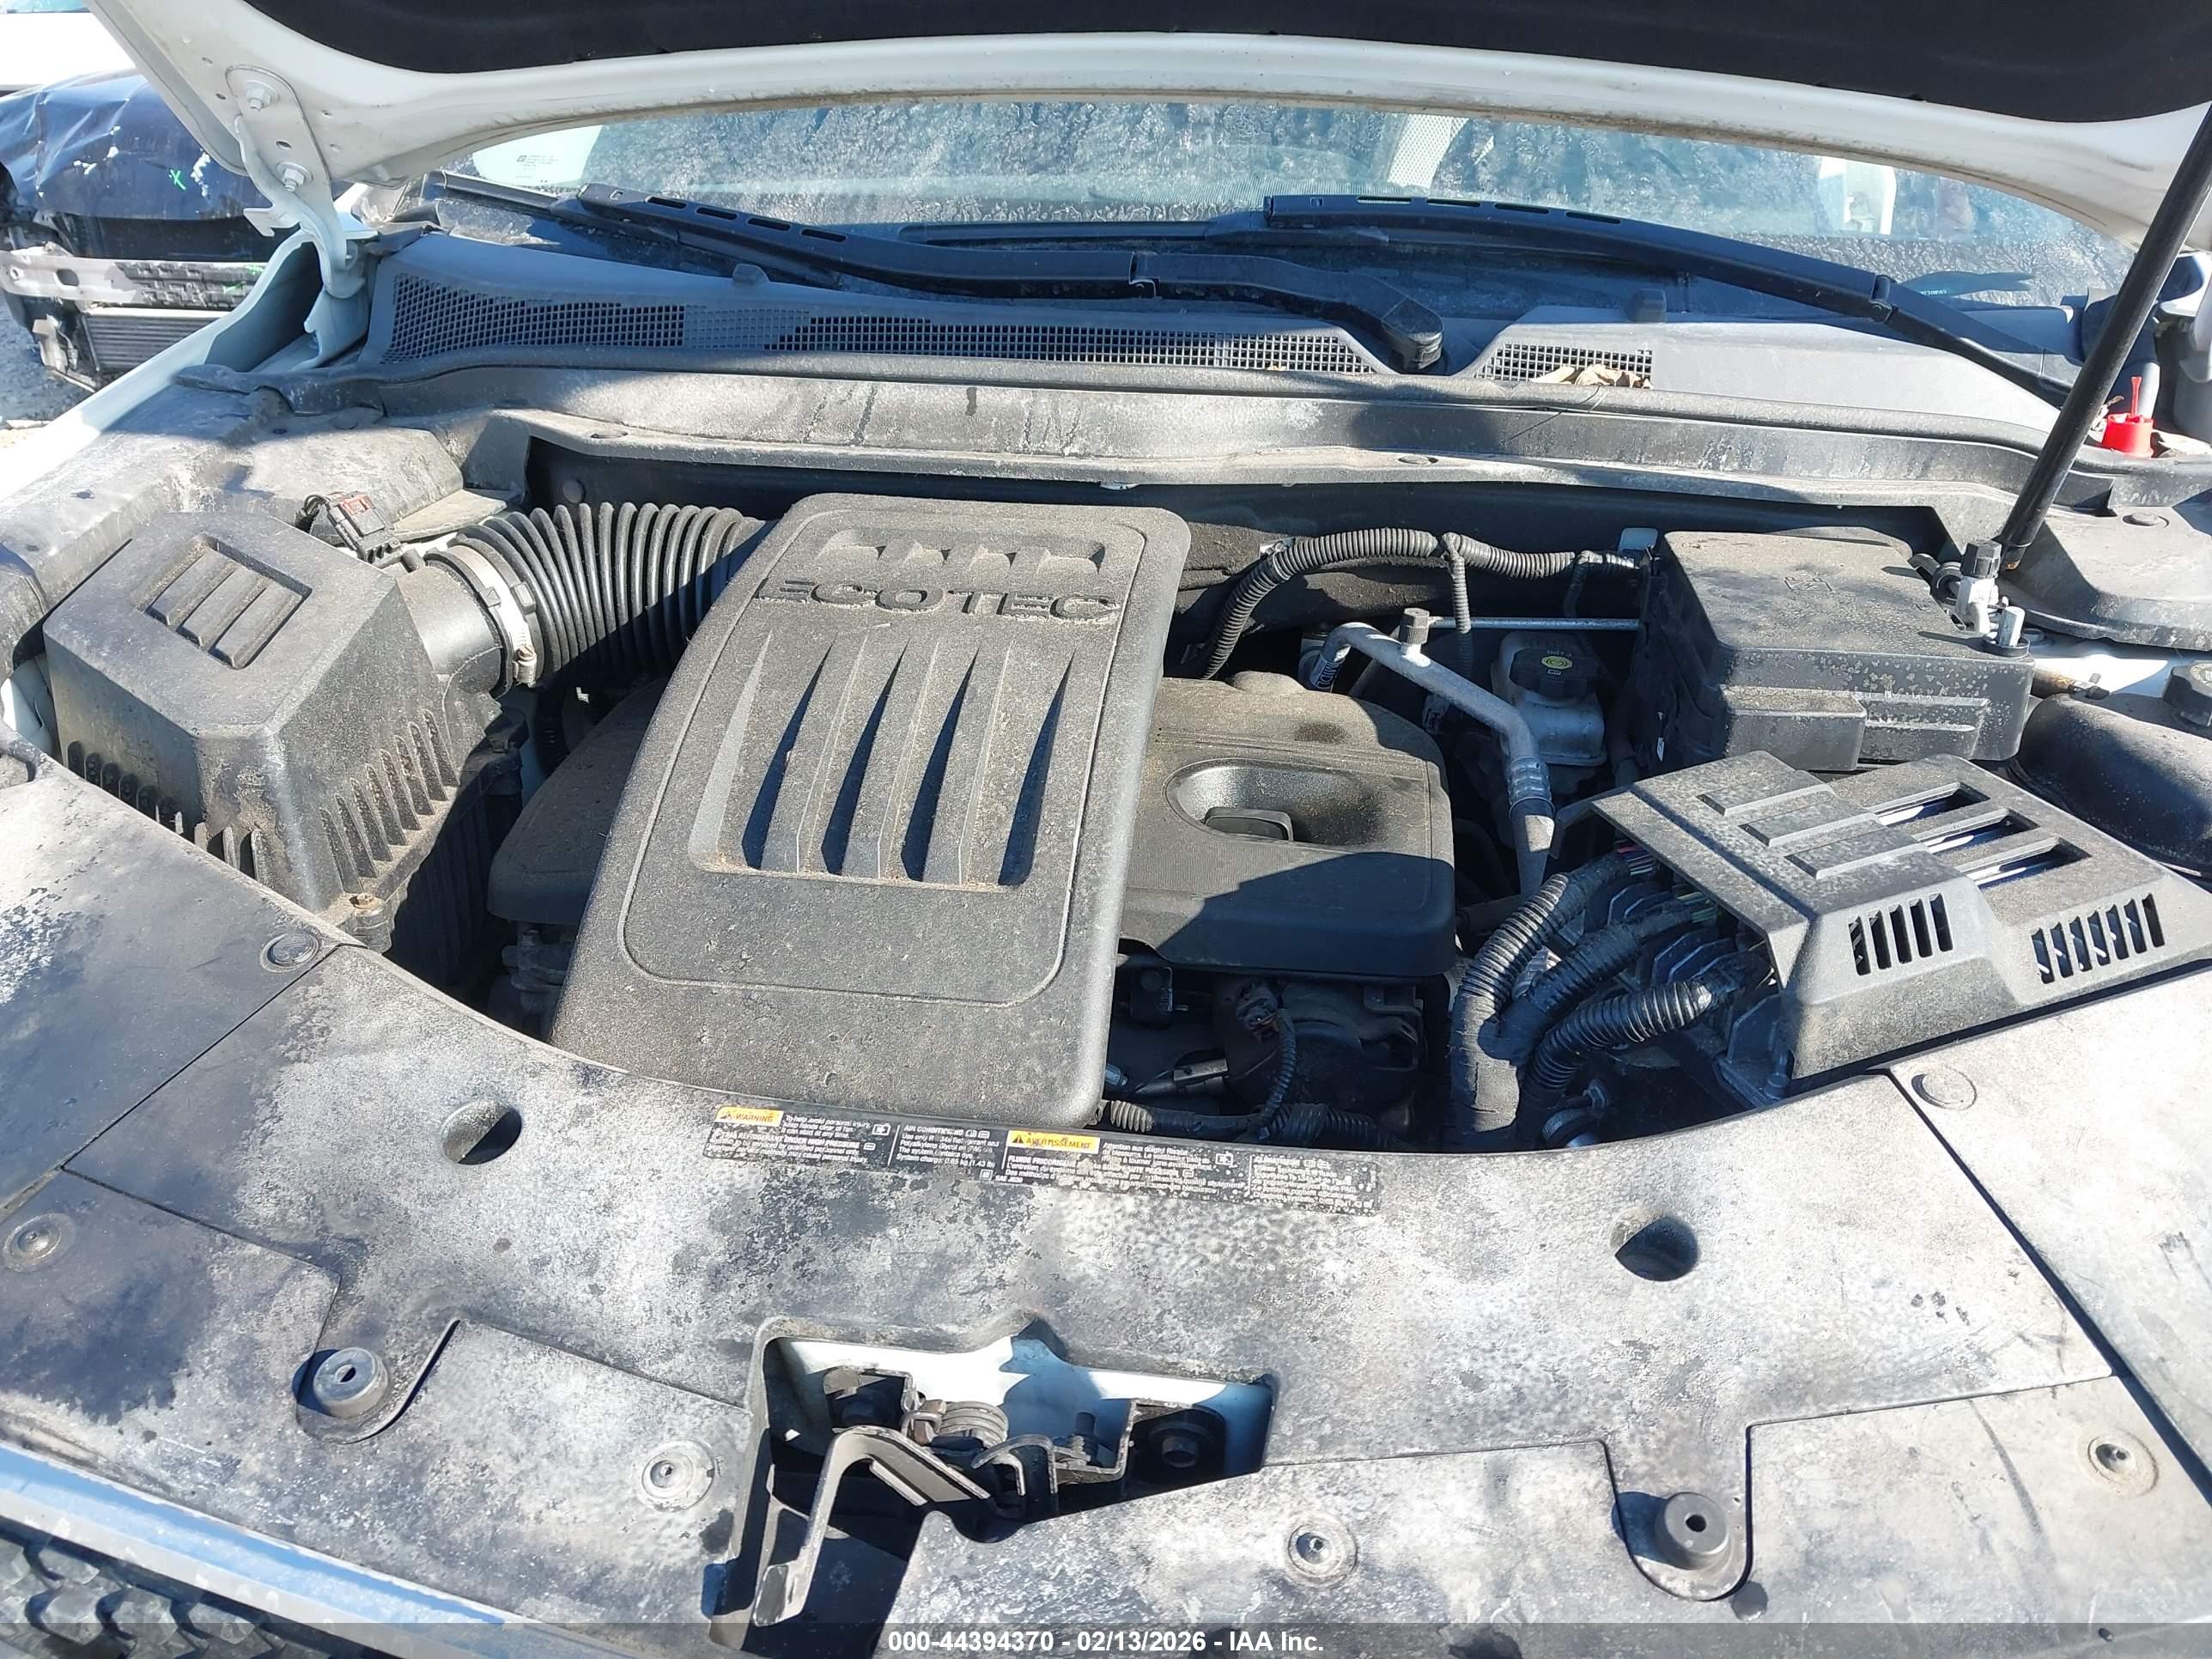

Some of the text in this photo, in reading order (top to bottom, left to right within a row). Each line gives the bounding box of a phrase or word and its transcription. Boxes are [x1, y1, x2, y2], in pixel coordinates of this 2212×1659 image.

[757, 577, 1121, 623] ECOTEC
[736, 1112, 773, 1122] WARNING
[825, 1118, 851, 1127] personal
[784, 1136, 806, 1145] UNDER
[826, 1139, 860, 1148] PRESSURE
[915, 1133, 927, 1142] only
[1026, 1138, 1092, 1149] AVERTISSEMENT
[823, 1154, 848, 1163] personal
[896, 1154, 920, 1163] System
